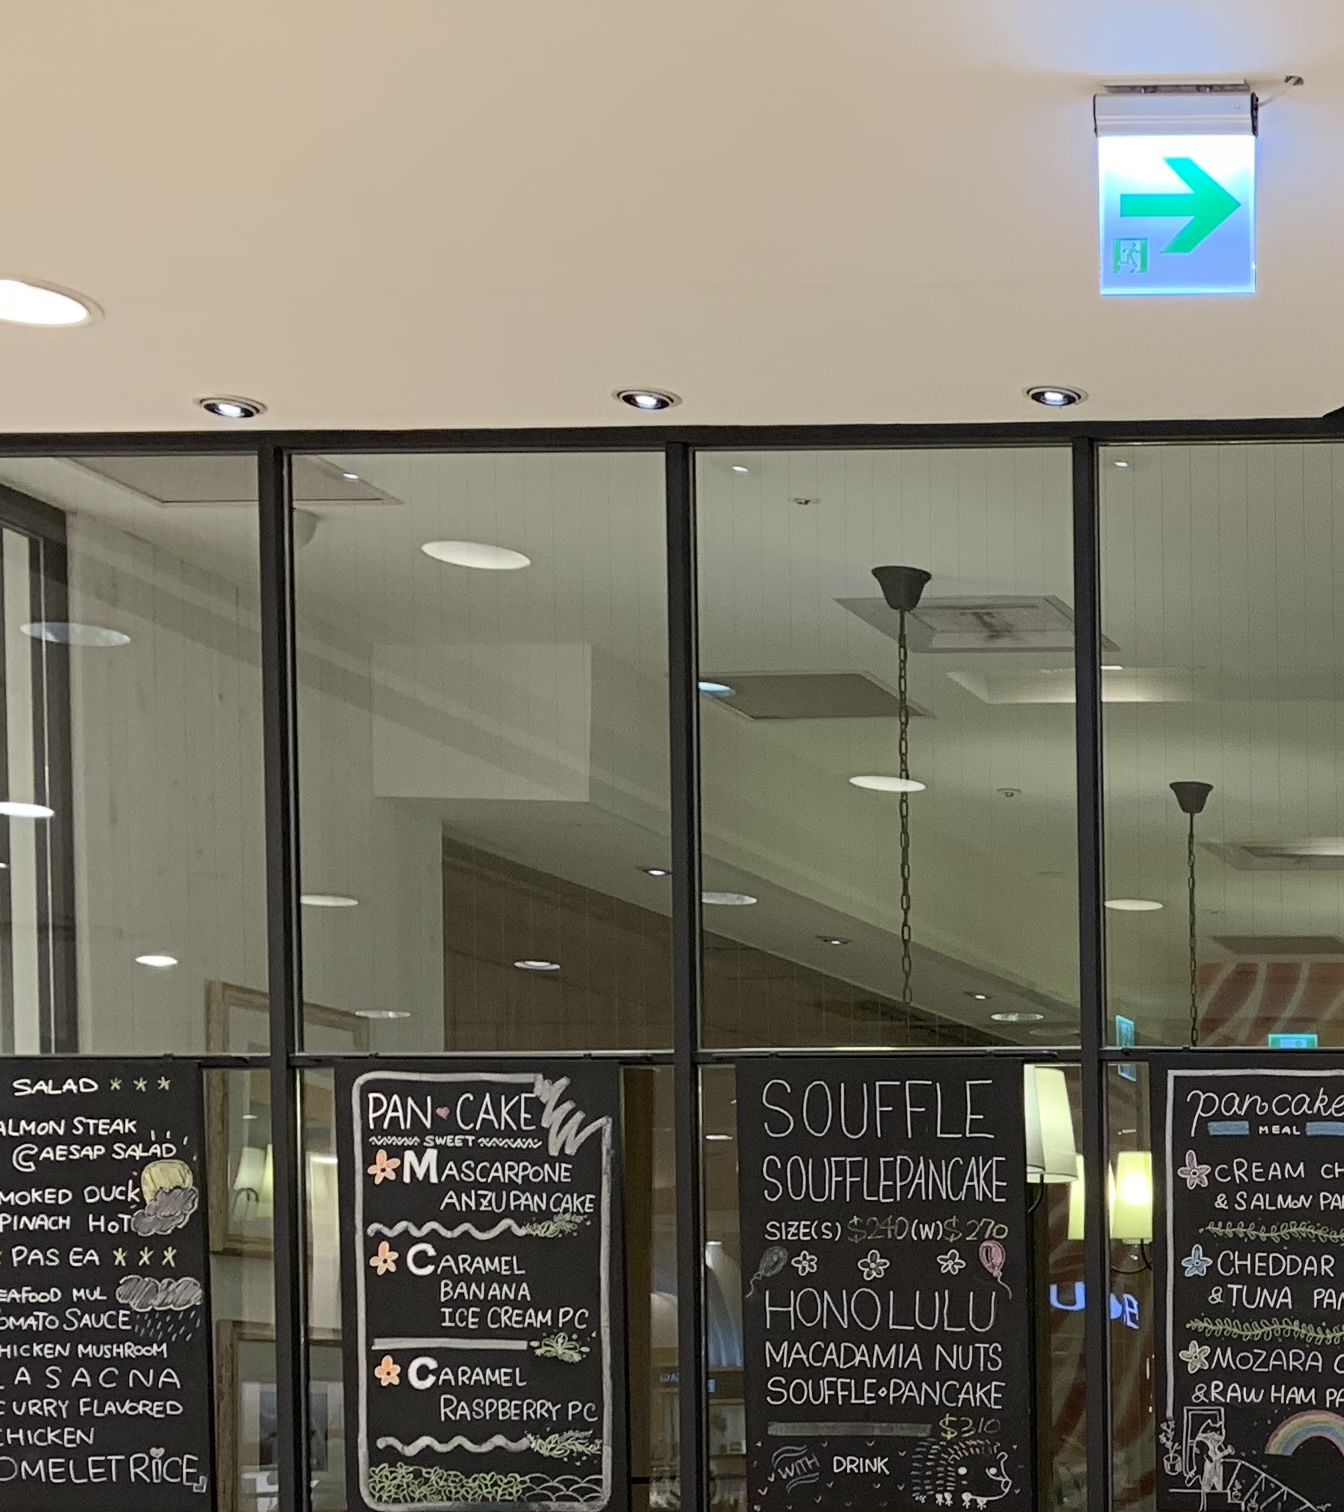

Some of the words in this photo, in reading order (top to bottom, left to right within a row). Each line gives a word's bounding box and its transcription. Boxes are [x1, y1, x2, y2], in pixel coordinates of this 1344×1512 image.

[12, 1078, 99, 1096] SALAD
[762, 1079, 995, 1139] SOUFFLE
[72, 1116, 137, 1136] STEAK
[1258, 1125, 1301, 1136] MEAL
[112, 1142, 177, 1160] SALAD
[424, 1135, 475, 1148] SWEET
[402, 1148, 572, 1184] MASCARPONE
[1214, 1158, 1306, 1184] CREAM
[1234, 1191, 1313, 1211] SALMON
[406, 1242, 526, 1276] CARAMEL
[1217, 1250, 1335, 1277] CHEDDAR
[440, 1281, 531, 1303] BANANA
[63, 1308, 132, 1331] SAUCE
[440, 1307, 482, 1329] ICE
[486, 1307, 552, 1329] CREAM
[558, 1308, 589, 1330] PC
[765, 1287, 996, 1332] HONOLULU
[77, 1341, 168, 1359] MUSHROOM
[765, 1341, 922, 1370] MACADAMIA
[935, 1343, 1002, 1371] NUTS
[1211, 1347, 1322, 1373] MOZARA
[407, 1356, 526, 1390] CARAMEL
[766, 1376, 877, 1405] SOUFFLE
[889, 1378, 1006, 1409] PANCAKE
[1271, 1383, 1316, 1405] HAM
[79, 1398, 183, 1418] FLAVORED
[440, 1395, 563, 1423] RASPBERRY
[568, 1400, 599, 1422] PC
[778, 1454, 821, 1480] WITH
[833, 1456, 890, 1475] DRINK
